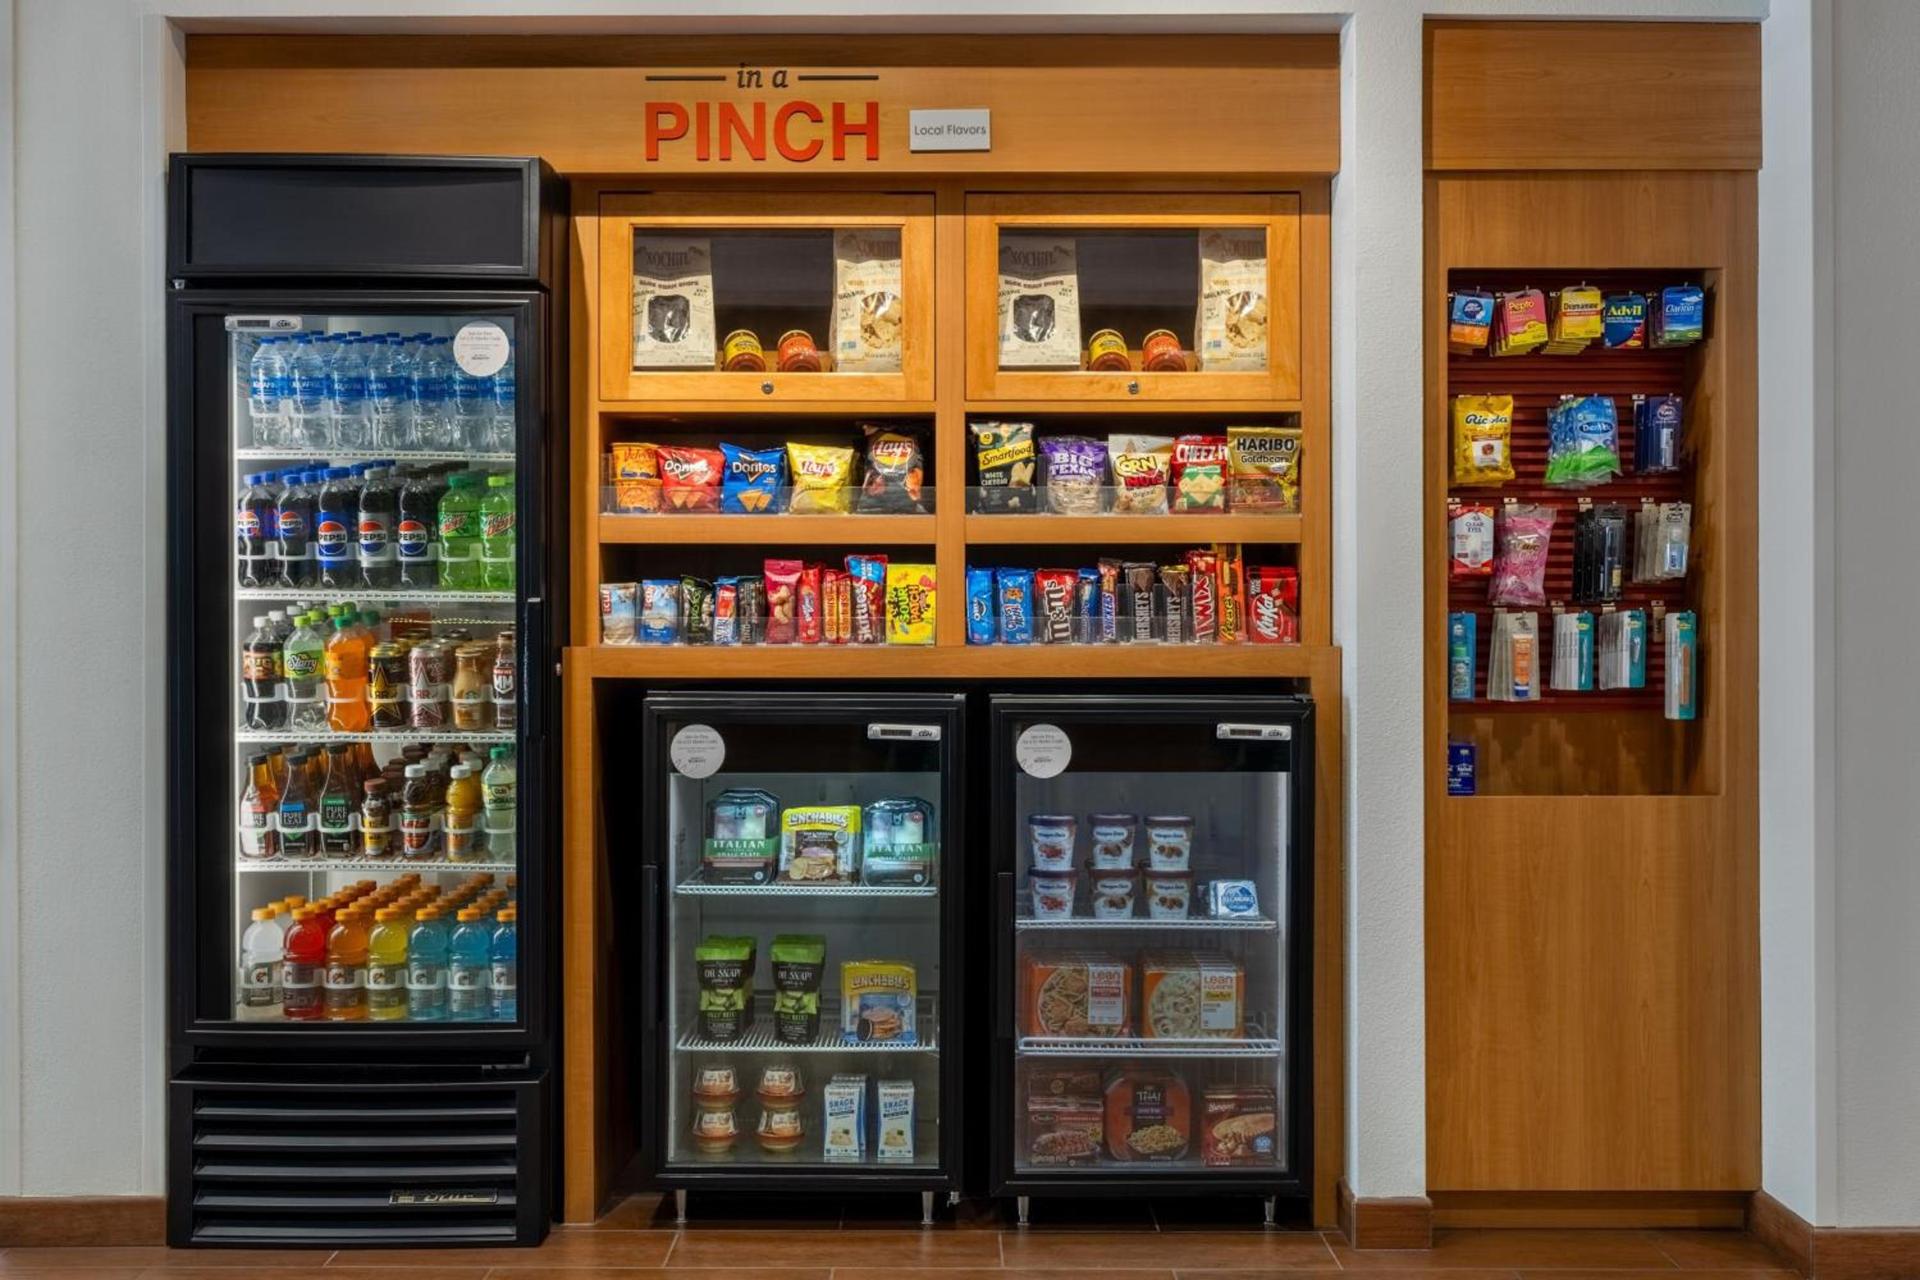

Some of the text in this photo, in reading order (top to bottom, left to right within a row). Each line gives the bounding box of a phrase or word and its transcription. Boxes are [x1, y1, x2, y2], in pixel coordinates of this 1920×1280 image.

[737, 63, 788, 88] in a
[645, 101, 879, 162] PINCH
[914, 124, 987, 136] Local Flavors
[1608, 305, 1642, 316] Advil
[1237, 438, 1294, 452] HARIBO
[982, 446, 1032, 466] Smartfood
[1055, 452, 1093, 467] BIG
[732, 461, 776, 474] Doritos
[1051, 465, 1096, 479] TEXAS
[320, 532, 346, 541] PEPSI
[400, 532, 426, 541] PEPSI
[898, 586, 911, 623] SOUR
[910, 585, 924, 624] PATCH
[1103, 593, 1116, 639] SNICKERS
[713, 840, 765, 848] ITALIAN
[871, 844, 923, 853] ITALIAN
[1136, 1092, 1161, 1102] THAI
